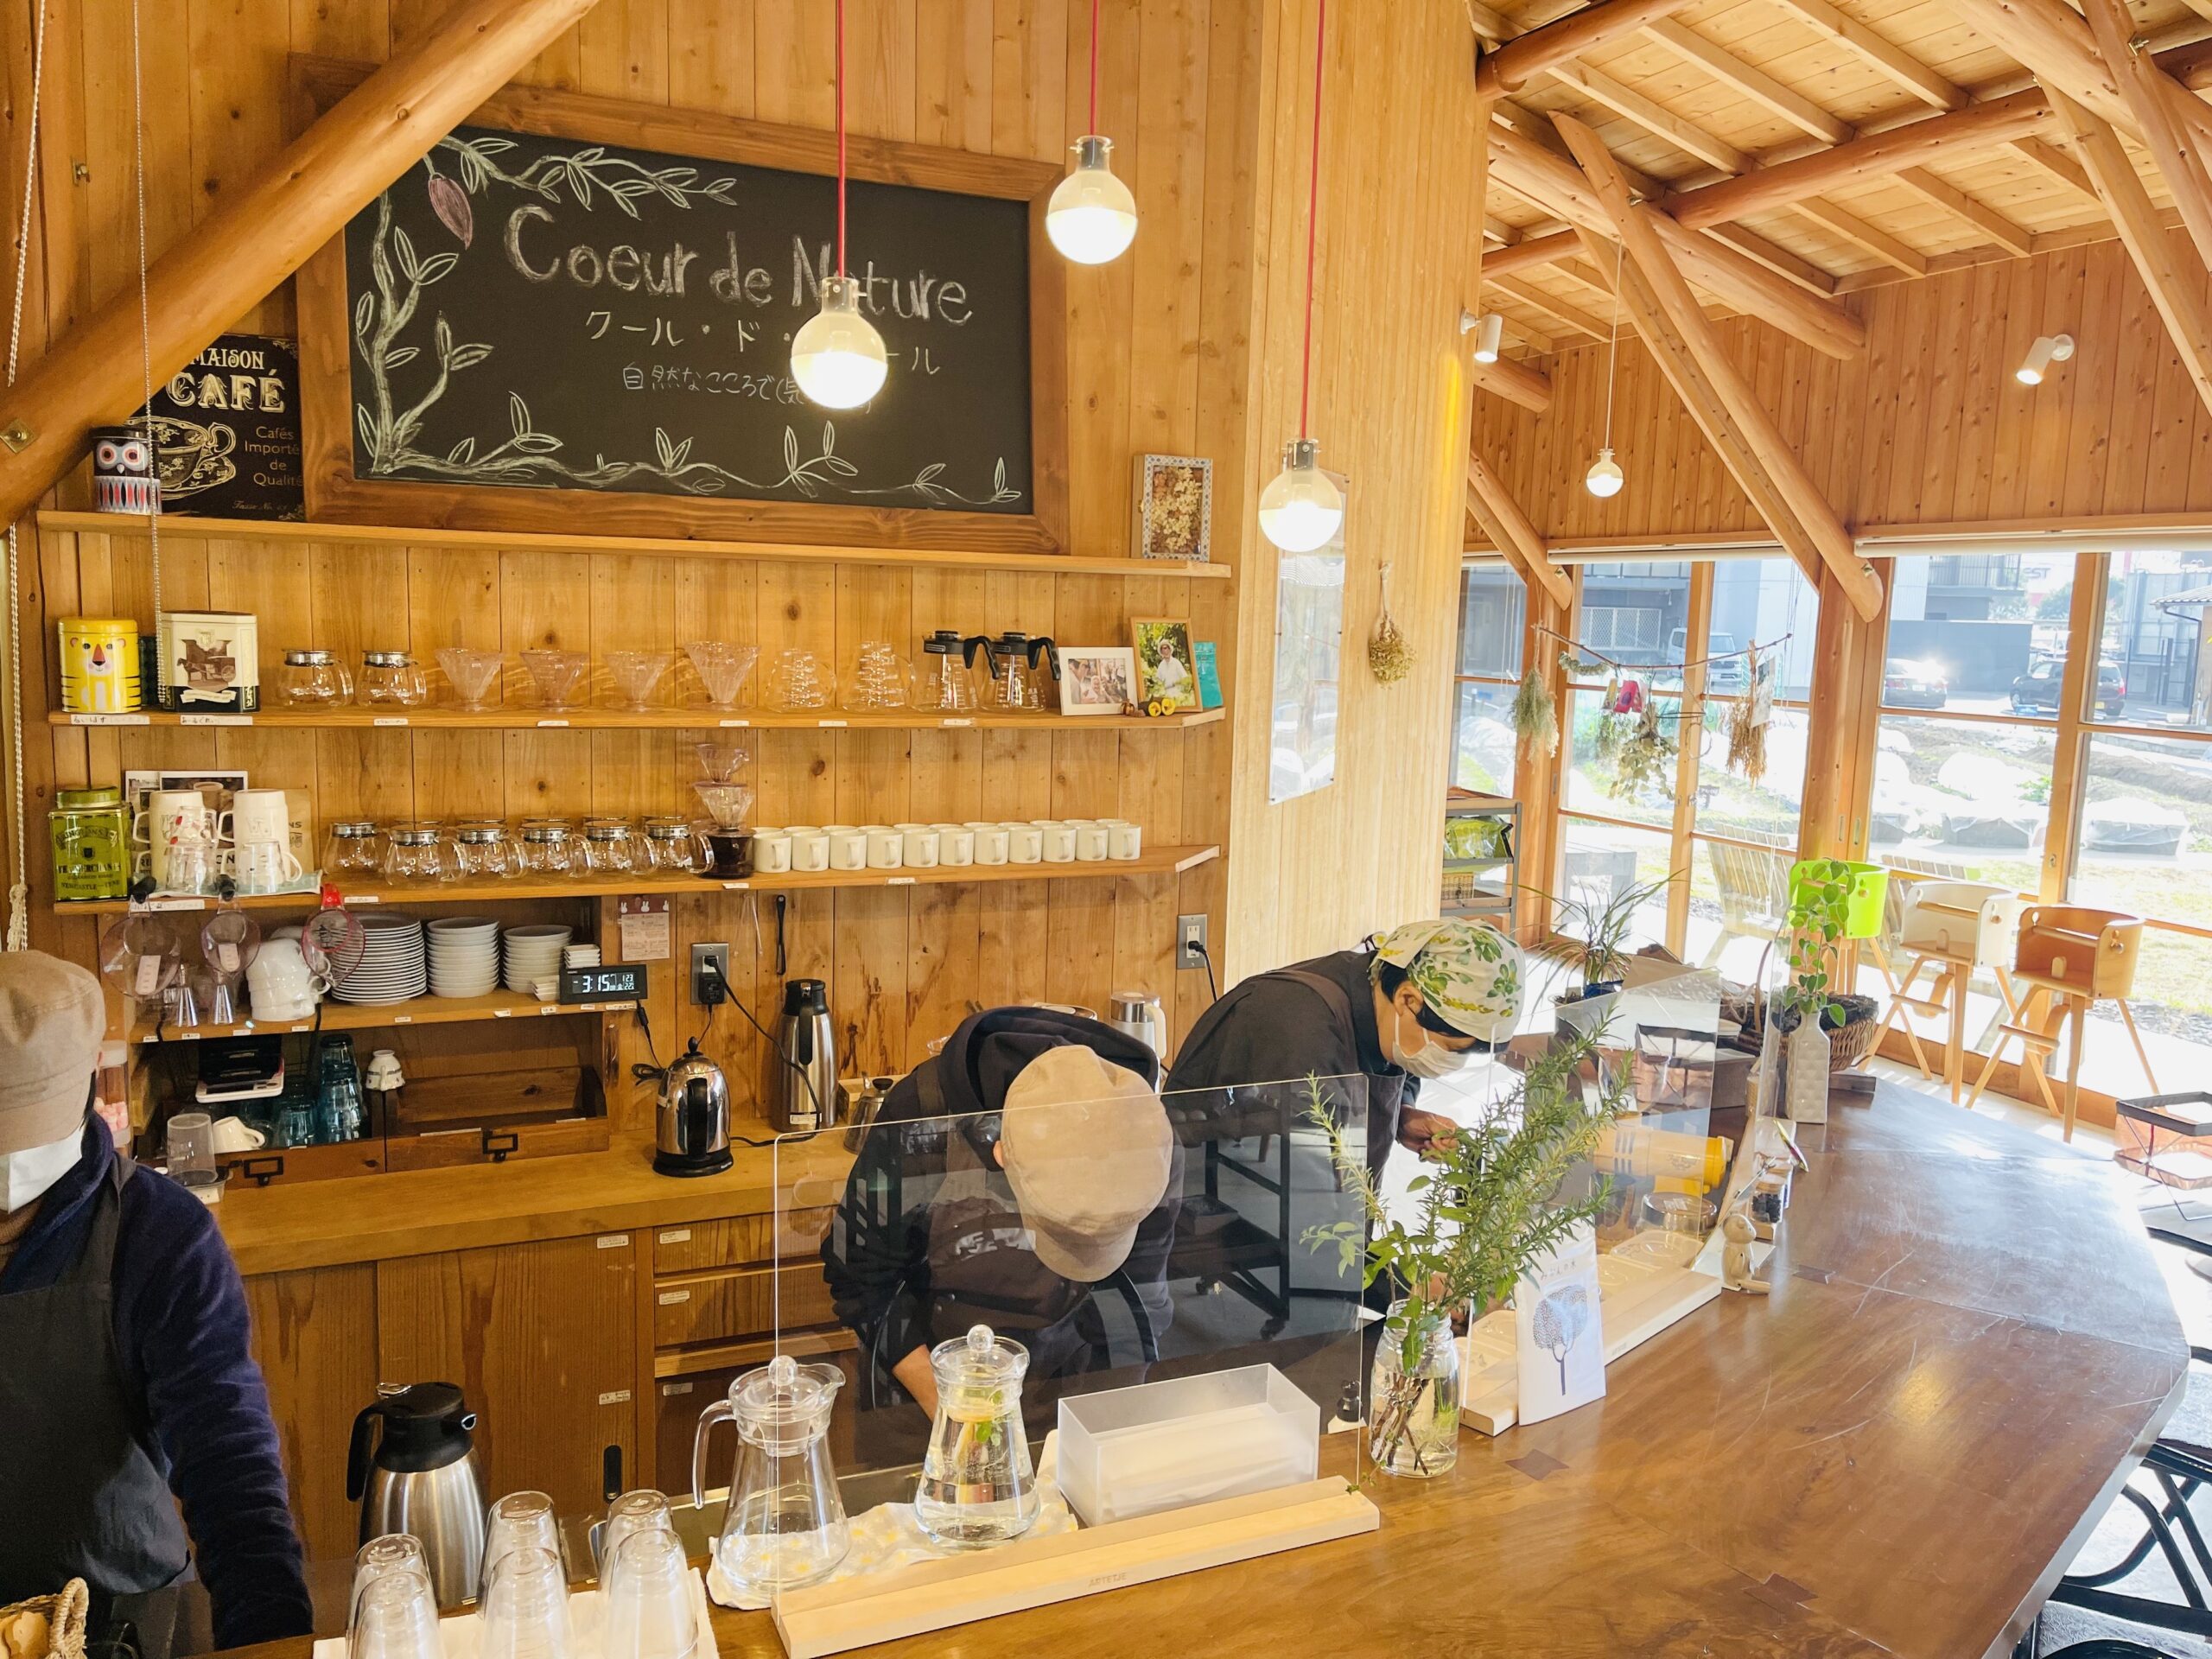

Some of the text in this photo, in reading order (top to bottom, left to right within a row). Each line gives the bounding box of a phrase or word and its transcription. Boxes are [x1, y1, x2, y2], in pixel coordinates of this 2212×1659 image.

[504, 203, 973, 327] Coeur de Nture
[165, 369, 286, 414] CAFÉ
[256, 425, 294, 440] Cafés
[269, 459, 287, 471] de
